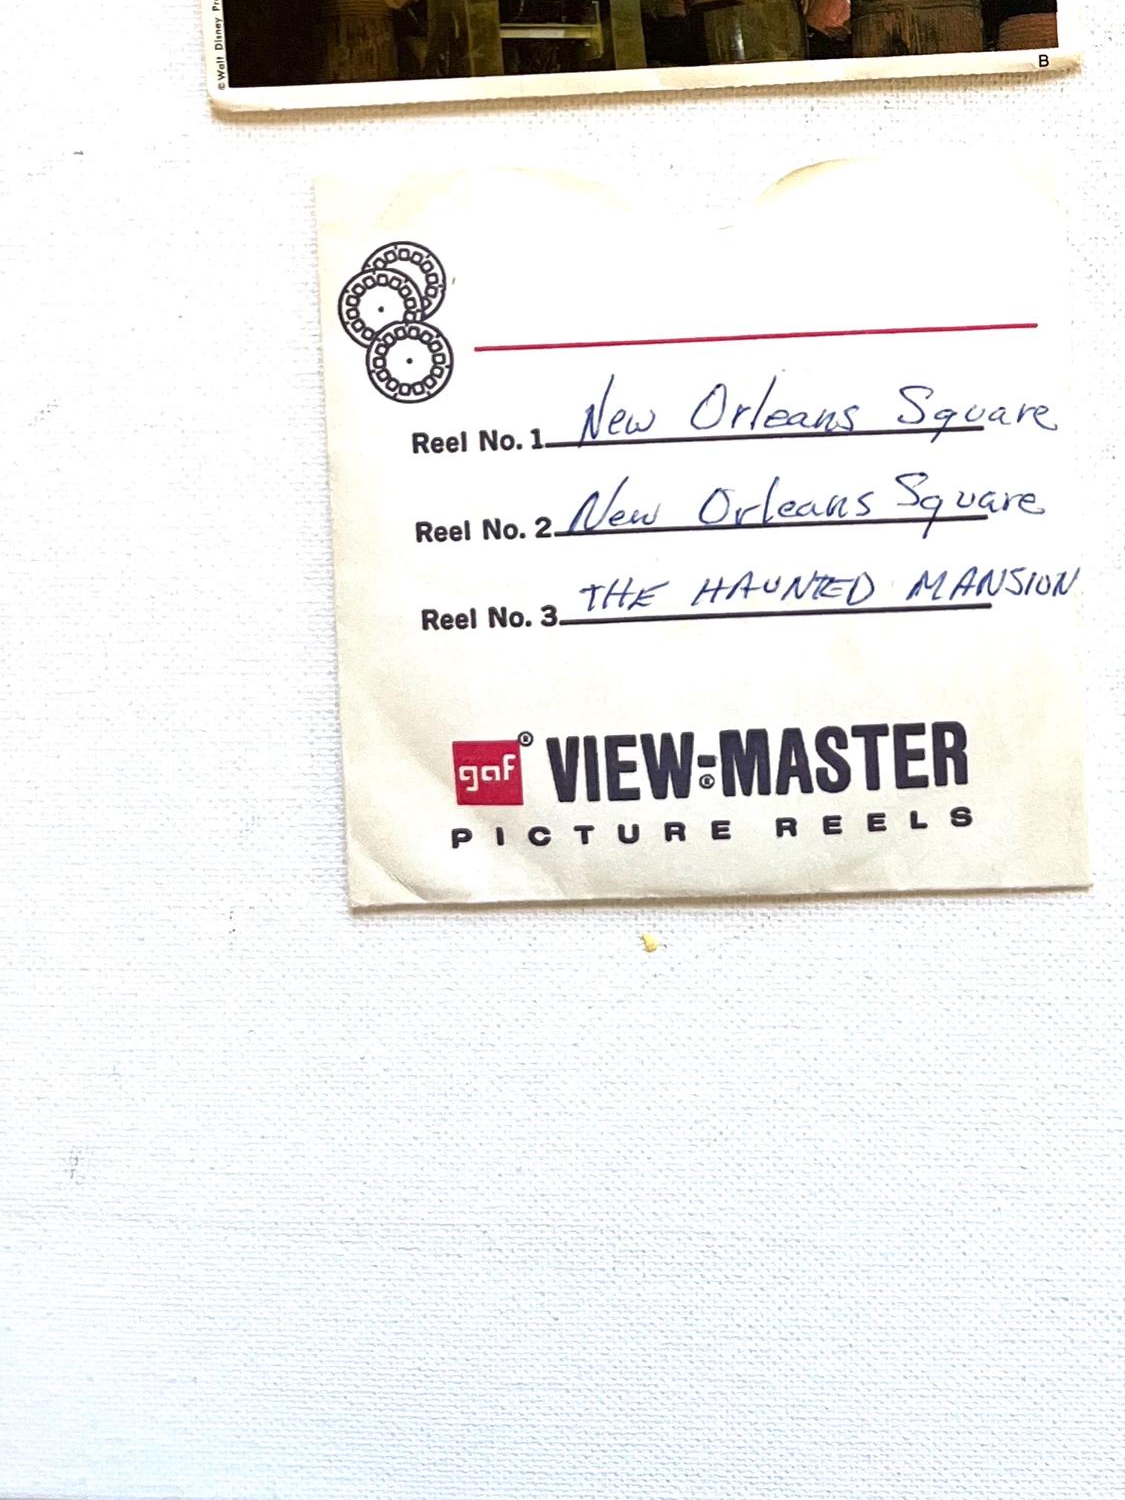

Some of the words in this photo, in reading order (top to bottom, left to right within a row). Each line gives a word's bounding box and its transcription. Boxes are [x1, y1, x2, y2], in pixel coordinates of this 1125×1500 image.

[215, 17, 223, 51] Disney
[216, 56, 226, 80] Walt
[1039, 56, 1049, 67] B
[578, 375, 656, 447] New
[690, 378, 857, 434] Orleans
[898, 386, 1058, 442] Square
[412, 430, 468, 454] Reel
[478, 426, 523, 452] No.
[531, 428, 543, 449] 1
[567, 476, 659, 536] New
[699, 476, 874, 523] Orleans
[895, 473, 1046, 538] Square
[416, 520, 472, 543] Reel
[482, 516, 527, 541] No.
[535, 518, 553, 538] 2
[578, 582, 667, 611] THE
[690, 574, 876, 608] HAUNTED
[906, 568, 1080, 604] MANSION
[421, 609, 477, 632] Reel
[488, 605, 533, 629] No.
[458, 754, 519, 795] gaf
[452, 822, 733, 849] PICTURE
[776, 807, 974, 837] REELS
